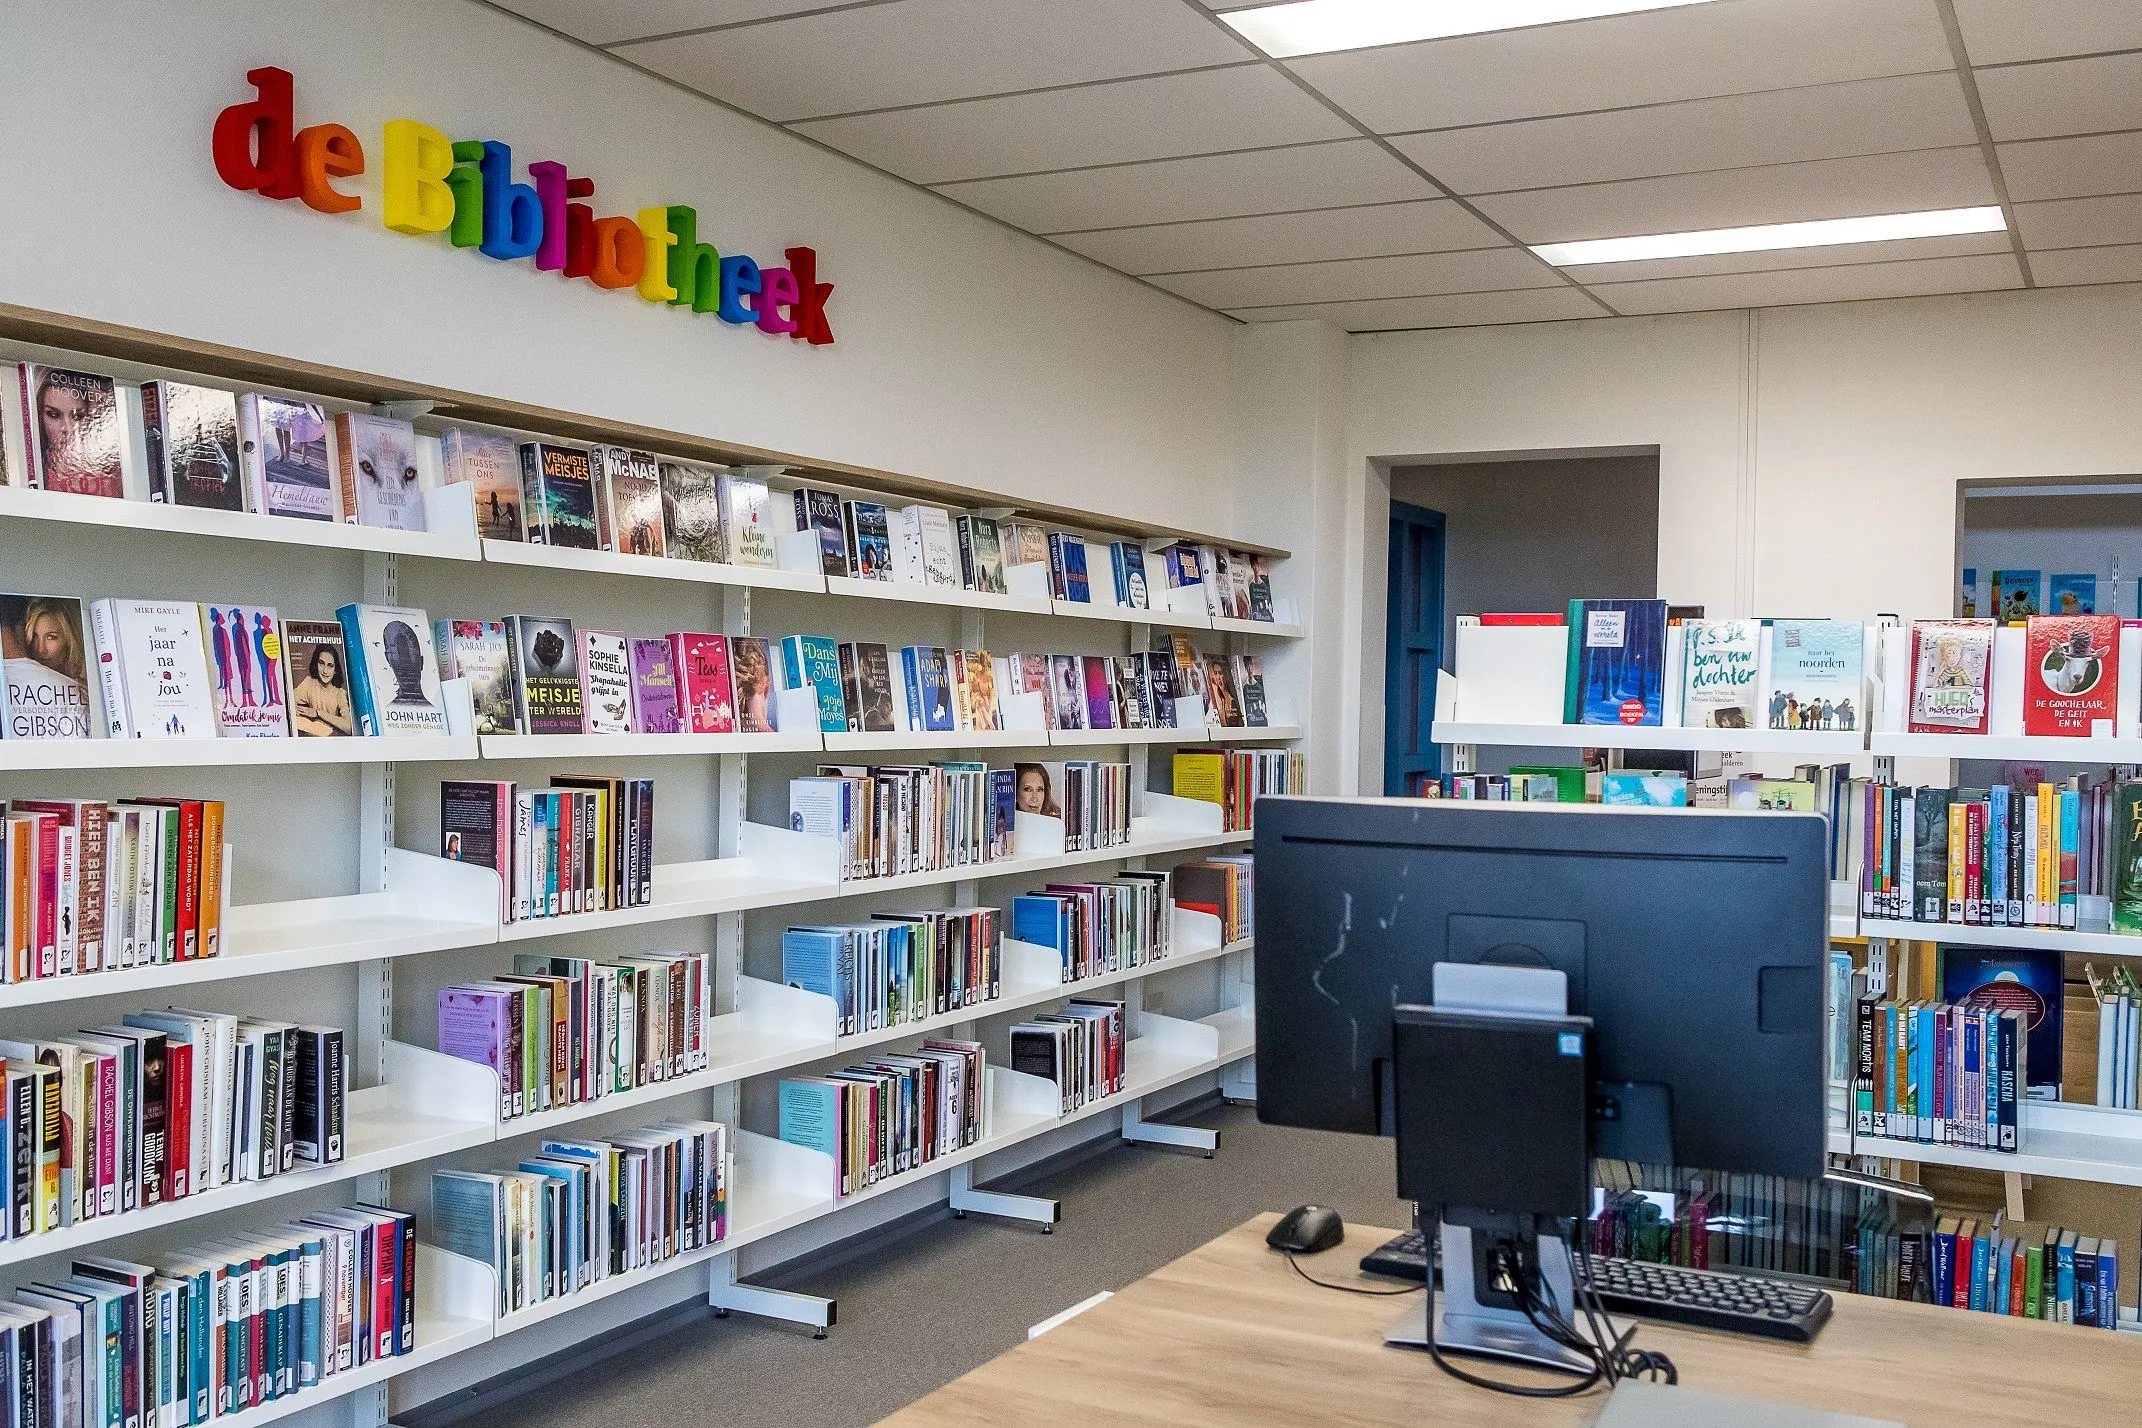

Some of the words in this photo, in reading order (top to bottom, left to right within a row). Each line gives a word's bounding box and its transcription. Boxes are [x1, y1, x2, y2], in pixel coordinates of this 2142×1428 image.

[212, 65, 365, 213] de
[383, 119, 834, 345] Bibliotheek
[51, 373, 101, 389] COLLEEN
[52, 386, 103, 402] HOOVER
[468, 457, 499, 469] TUSSEN
[543, 450, 588, 468] VERMISTE
[609, 448, 631, 461] ANDY
[476, 469, 494, 480] ONS
[544, 463, 590, 481] MEISJES
[813, 492, 834, 503] TOMAS
[810, 501, 839, 519] ROSS
[288, 624, 310, 634] ANNE
[312, 625, 342, 635] FRANK
[149, 636, 176, 652] jaar
[289, 635, 301, 643] HET
[303, 635, 343, 645] ACHTERHUIS
[460, 642, 487, 651] SARAH
[589, 650, 619, 663] SOPHIE
[802, 642, 836, 661] Dans
[1693, 649, 1722, 667] ben
[1727, 650, 1753, 663] uw
[157, 657, 175, 667] na
[589, 660, 629, 675] KINSELLA
[651, 662, 666, 677] Jill
[695, 656, 718, 676] Tess
[1799, 657, 1845, 669] noorden
[539, 677, 579, 685] GELUKKIGSTE
[589, 674, 628, 688] Shopaholic
[640, 673, 674, 687] Mansell
[813, 661, 839, 686] Mij
[1692, 665, 1757, 689] dochter
[9, 684, 89, 706] RACHEL
[158, 680, 182, 697] jou
[526, 687, 580, 703] MEISJE
[590, 686, 610, 697] grijpt
[611, 687, 619, 696] in
[529, 707, 545, 715] TER
[548, 707, 581, 715] WERELD
[1928, 705, 1979, 717] masterplan
[2036, 699, 2046, 708] DE
[221, 709, 248, 723] Omdat
[266, 712, 281, 723] mis
[385, 710, 414, 723] JOHN
[416, 711, 443, 723] HART
[818, 707, 845, 724] Moyes
[2054, 710, 2064, 718] DE
[2067, 709, 2087, 718] GEIT
[13, 716, 89, 737] GIBSON
[2058, 719, 2069, 728] EN
[518, 800, 531, 837] James
[88, 809, 101, 852] HIER
[496, 819, 504, 849] house
[573, 807, 581, 869] GIBRALTAR
[186, 844, 194, 884] ZATERDAG
[208, 815, 217, 901] DONDERDAGSKINDEREN
[64, 862, 72, 883] JONES
[88, 858, 100, 890] BEN
[128, 861, 136, 891] FOSSUM
[1931, 879, 1946, 888] Tom
[165, 879, 173, 911] VRIJDAG
[87, 899, 100, 922] IK
[1862, 1019, 1872, 1041] TEAM
[329, 1040, 340, 1069] Joanne
[1861, 1042, 1874, 1073] MORTIS
[202, 1057, 210, 1101] GRISHAM
[264, 1059, 280, 1085] Weg
[286, 1066, 294, 1082] HUIS
[104, 1065, 115, 1099] RACHEL
[285, 1083, 293, 1098] AAN
[330, 1069, 341, 1095] Harris
[2001, 1070, 2014, 1102] KASCHA
[20, 1085, 32, 1116] ELLEN
[127, 1088, 134, 1100] DE
[262, 1089, 276, 1119] naar
[284, 1100, 292, 1109] DE
[20, 1117, 32, 1129] G.
[104, 1100, 115, 1133] GIBSON
[284, 1110, 292, 1133] RIVIER
[330, 1095, 341, 1136] Schaakma
[88, 1139, 95, 1153] de
[104, 1133, 112, 1147] KUS
[126, 1101, 134, 1176] ONVERBIDDELIJKE
[155, 1130, 165, 1162] TERRY
[104, 1147, 112, 1158] ME
[143, 1132, 156, 1185] GOODKIND
[87, 1154, 96, 1179] sluier
[406, 1228, 413, 1240] DE
[380, 1235, 394, 1276] ORPHAN
[404, 1240, 412, 1292] NERGENSMAN
[279, 1268, 287, 1294] LOES
[380, 1275, 394, 1285] X
[346, 1282, 354, 1313] HOOVER
[144, 1292, 156, 1329] HOAG
[26, 1359, 33, 1371] IN
[26, 1373, 34, 1395] HET
